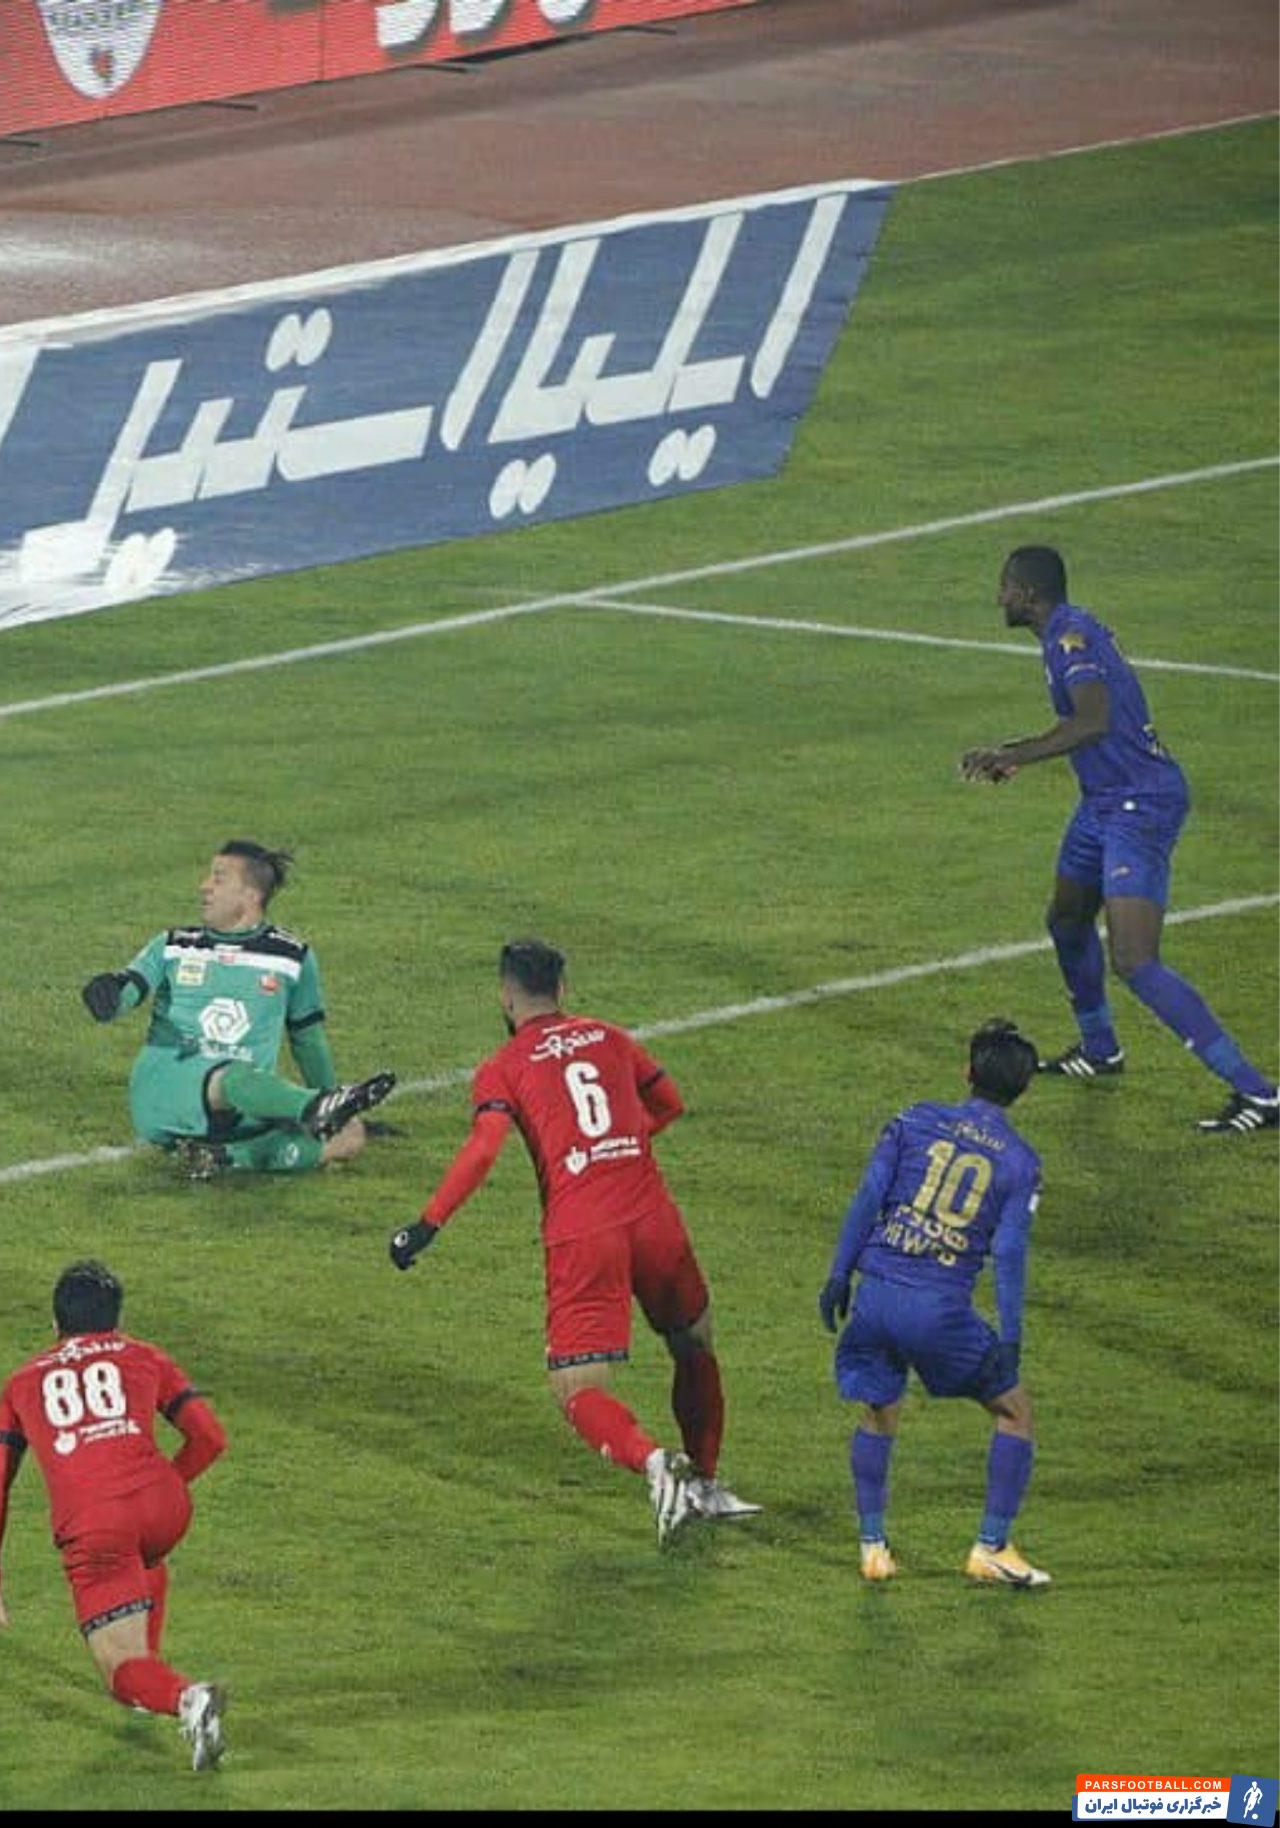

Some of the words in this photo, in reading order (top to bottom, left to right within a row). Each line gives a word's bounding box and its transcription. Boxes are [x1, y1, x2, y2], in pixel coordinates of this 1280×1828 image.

[487, 192, 847, 519] ایلیا
[20, 250, 540, 590] استیل
[564, 1061, 612, 1138] 6
[913, 1140, 992, 1228] 10
[42, 1361, 127, 1427] 88
